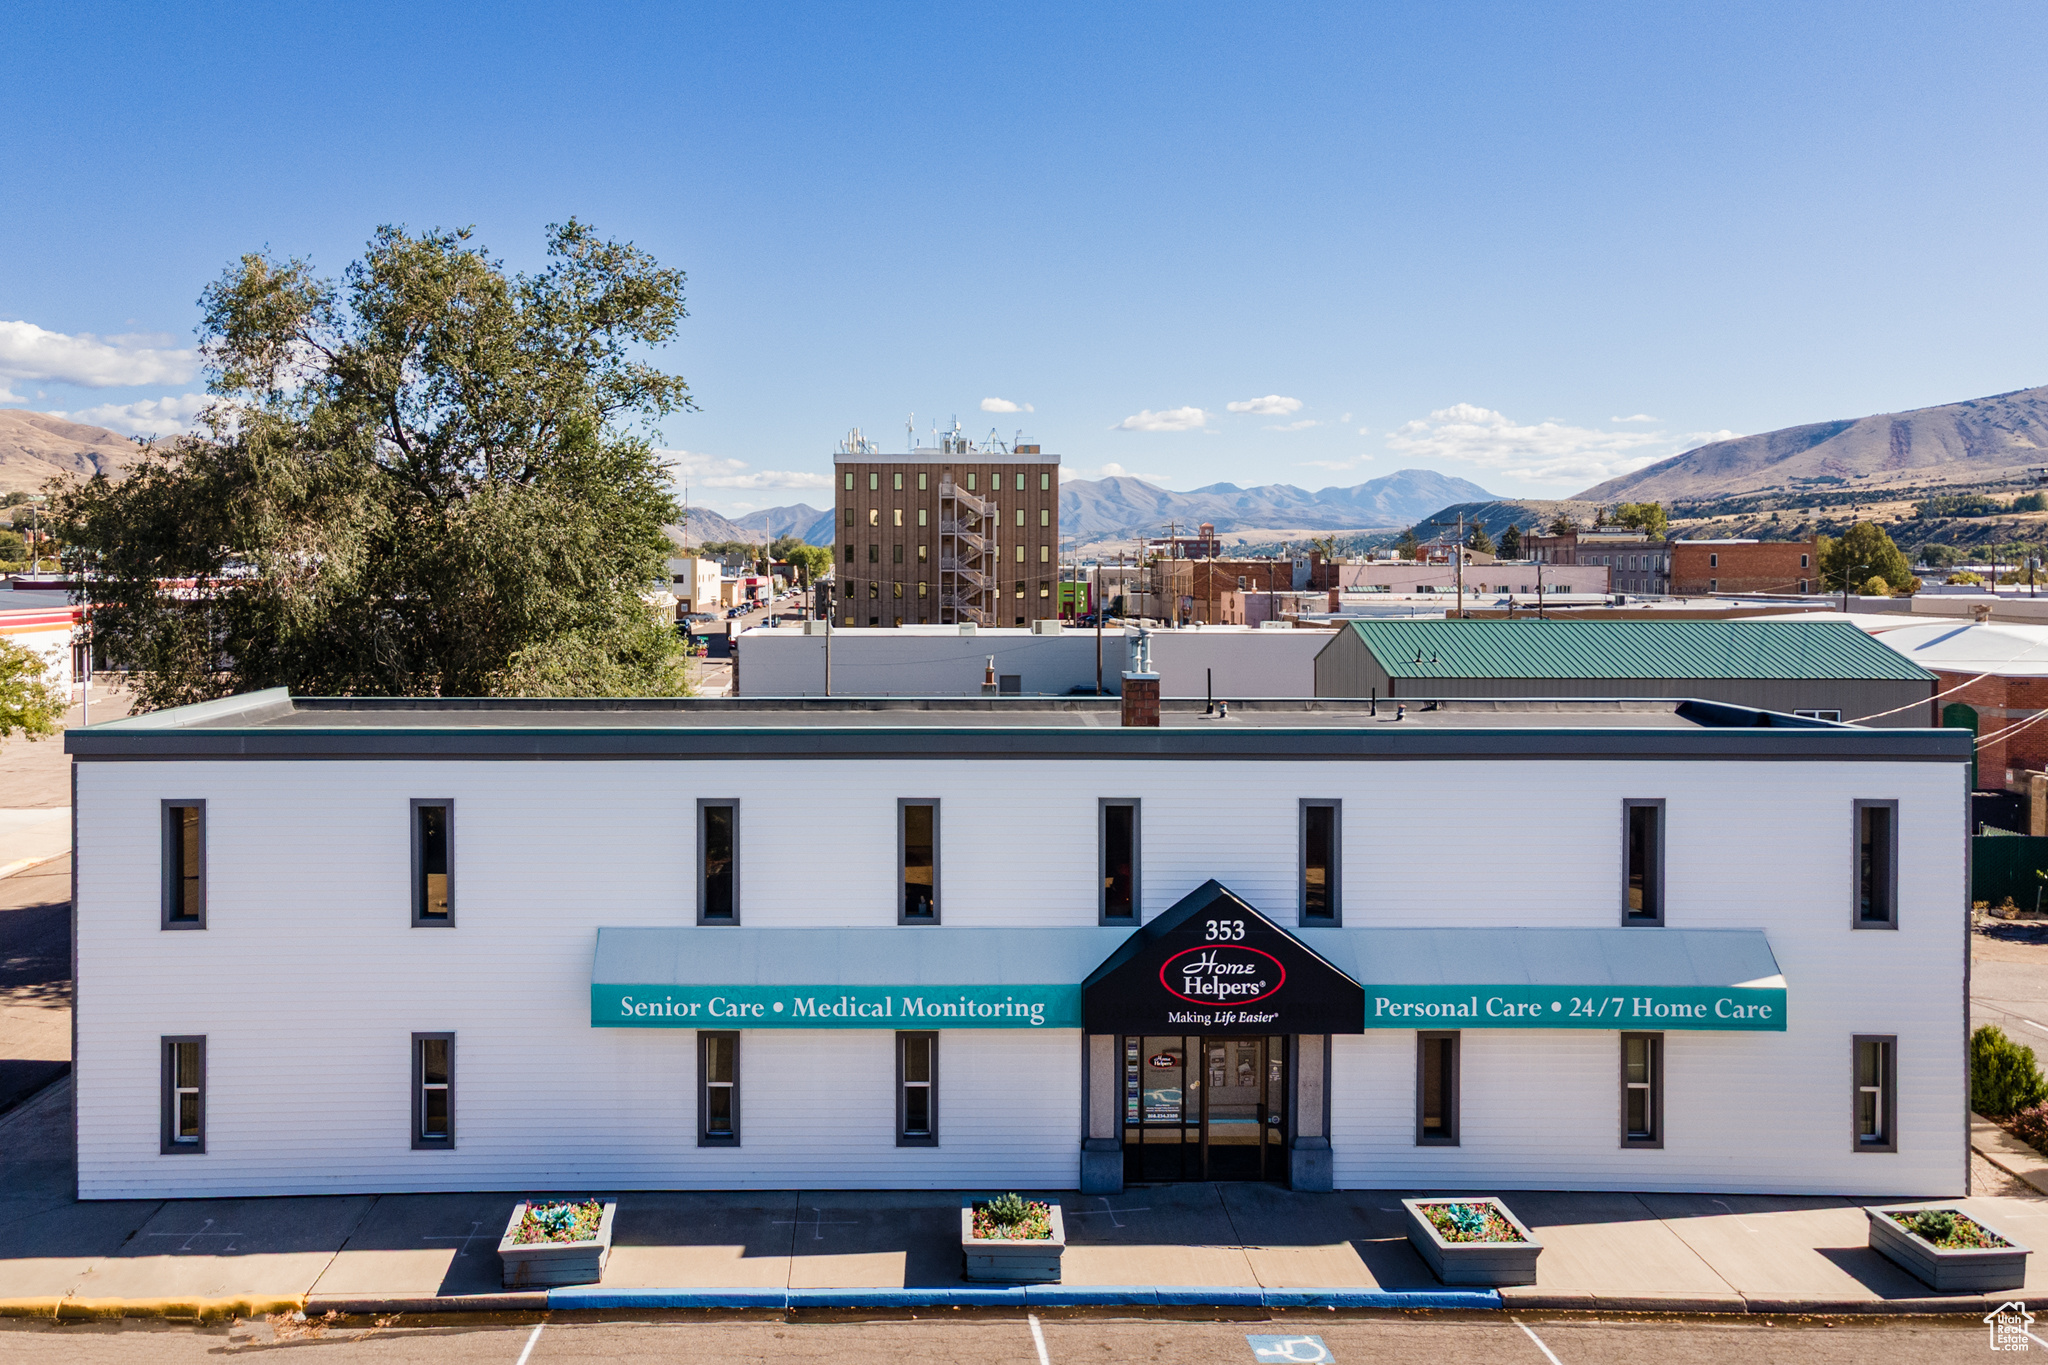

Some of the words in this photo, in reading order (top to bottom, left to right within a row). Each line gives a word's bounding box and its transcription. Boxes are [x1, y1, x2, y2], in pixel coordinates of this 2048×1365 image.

[1205, 919, 1246, 941] 353
[1182, 950, 1256, 975] Home
[620, 996, 701, 1017] Senior
[708, 996, 765, 1018] Care
[792, 996, 893, 1018] Medical
[900, 996, 1045, 1025] Monitoring
[1168, 1011, 1211, 1026] Making
[1214, 1011, 1237, 1026] Life
[1375, 996, 1478, 1017] Personal
[1485, 997, 1542, 1017] Care
[1569, 997, 1624, 1017] 24/7
[1632, 998, 1707, 1018] Home
[1714, 998, 1772, 1019] Care
